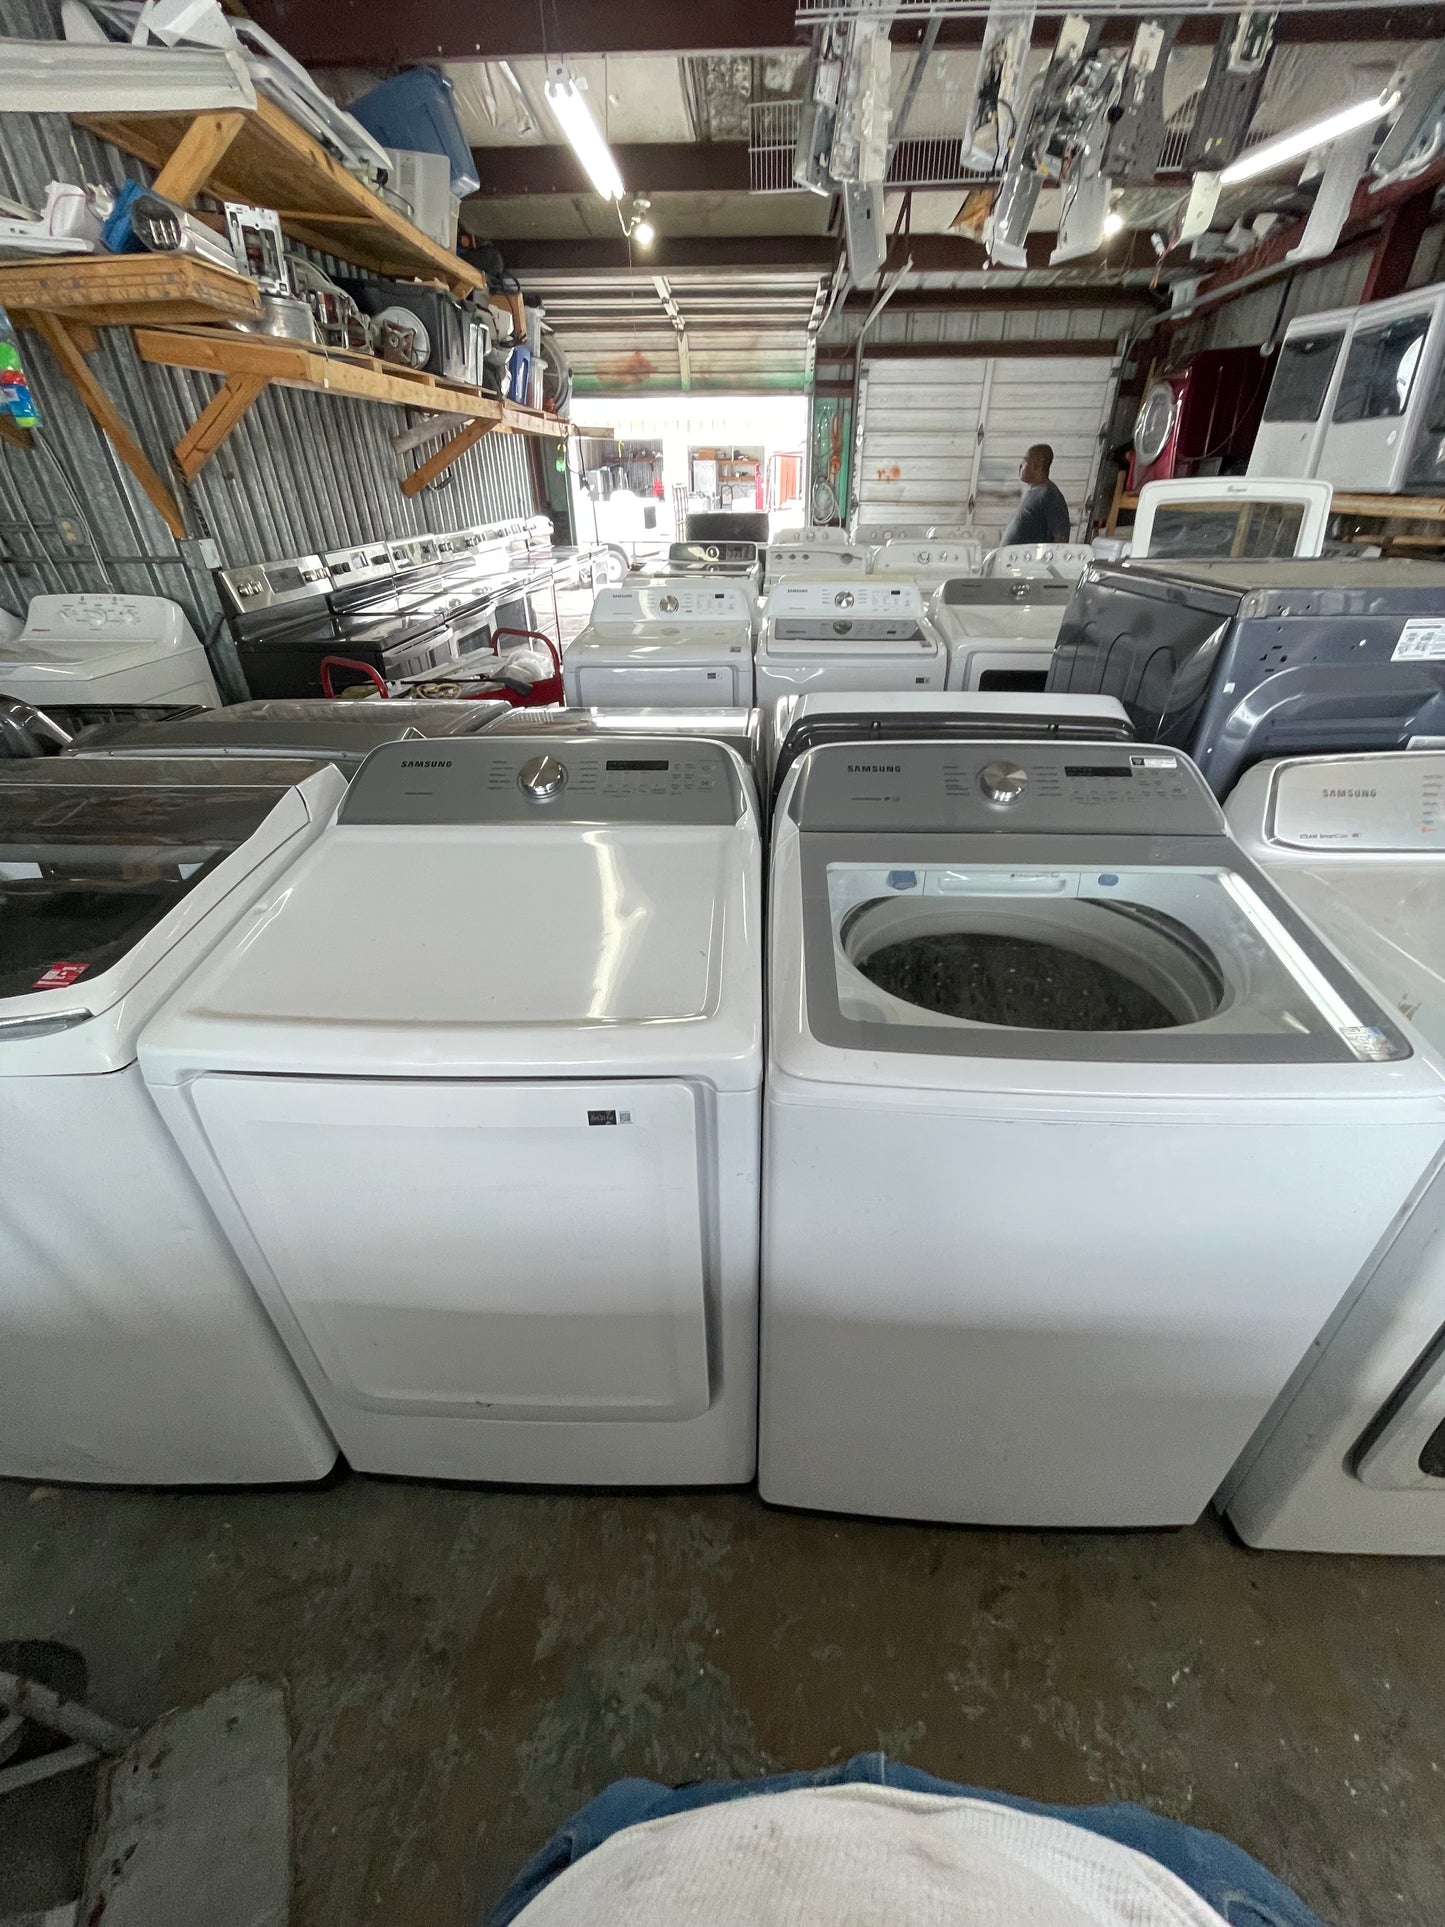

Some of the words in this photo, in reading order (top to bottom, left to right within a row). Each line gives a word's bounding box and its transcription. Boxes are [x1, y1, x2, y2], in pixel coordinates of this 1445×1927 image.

[401, 760, 453, 768] SAMSUNG
[847, 764, 901, 773] SAMSUNG
[1322, 788, 1377, 798] SAMSUNG
